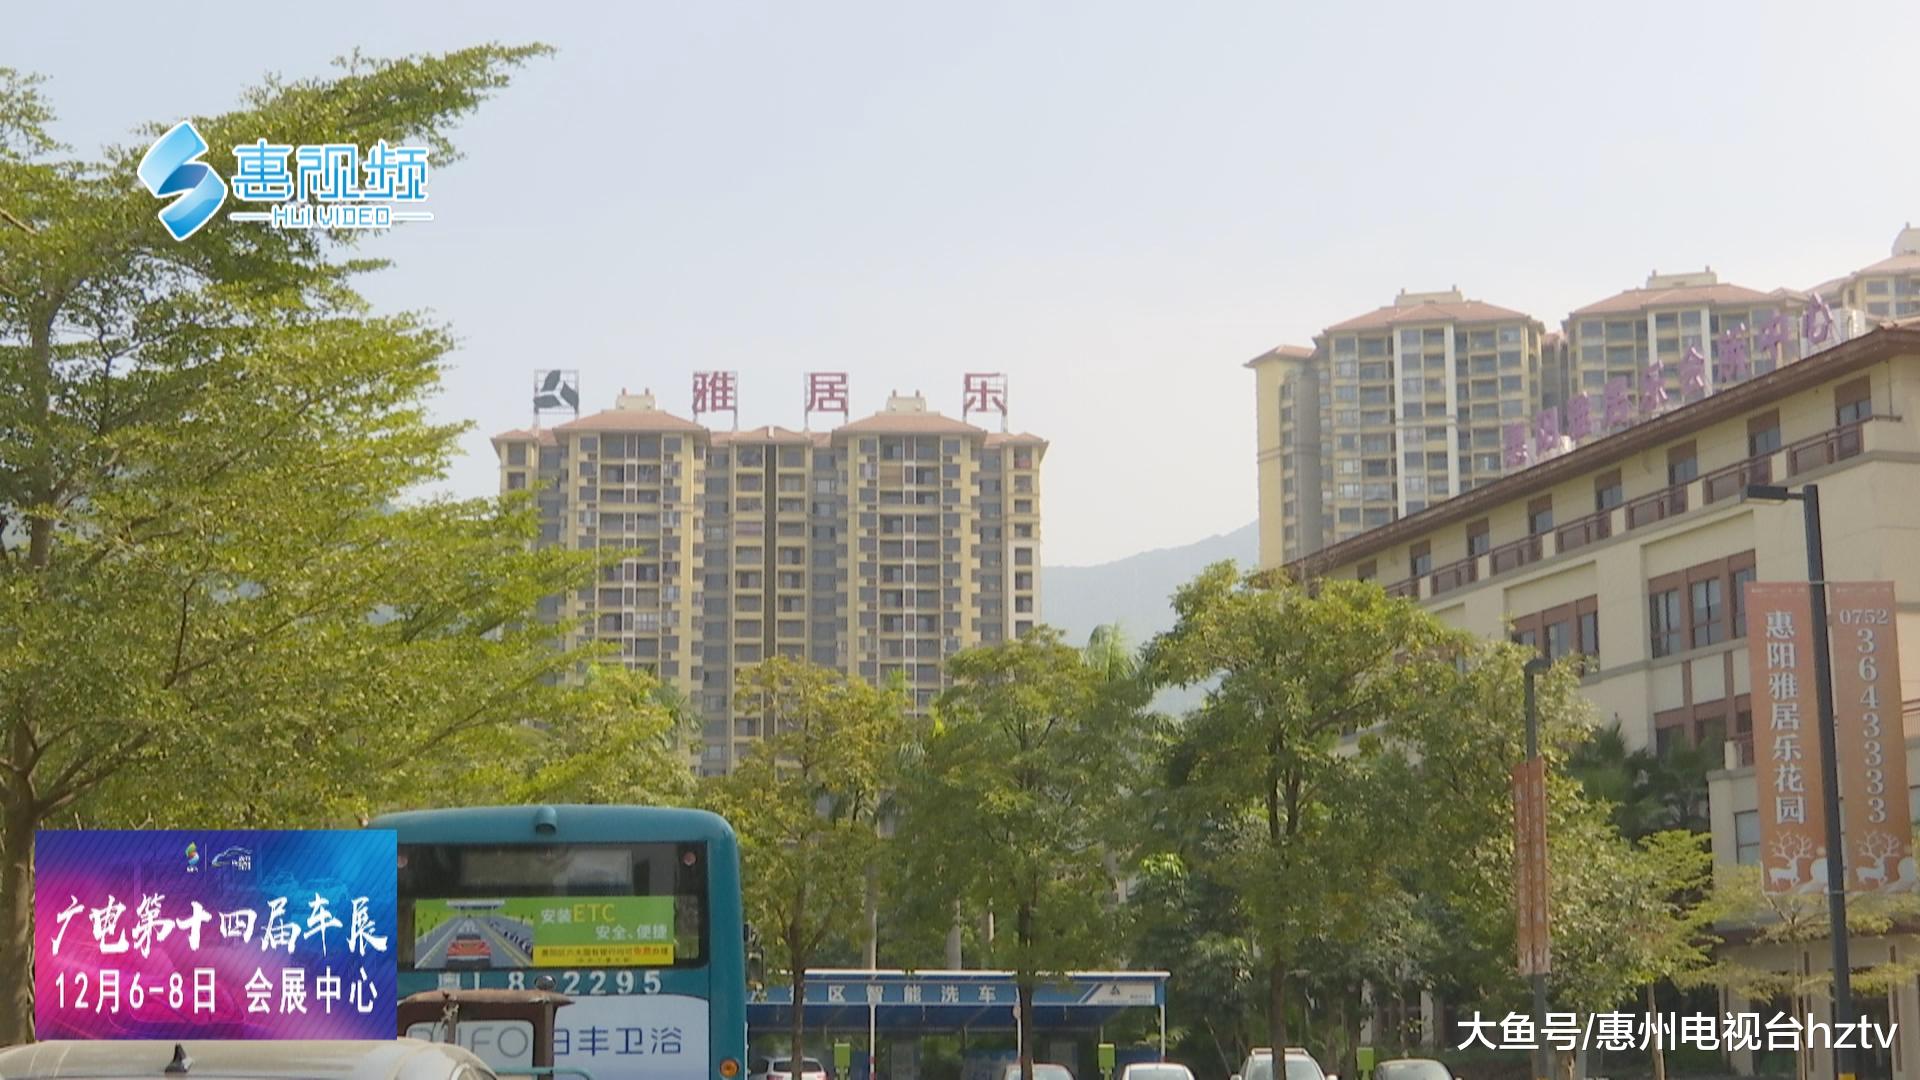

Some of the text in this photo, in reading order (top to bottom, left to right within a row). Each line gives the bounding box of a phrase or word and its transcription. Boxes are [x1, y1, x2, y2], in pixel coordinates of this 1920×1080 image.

[692, 371, 1008, 413] 雅居乐
[1838, 608, 1889, 626] 0752
[1764, 610, 1806, 825] 惠阳雅居乐花园
[1856, 628, 1888, 824] 3643333
